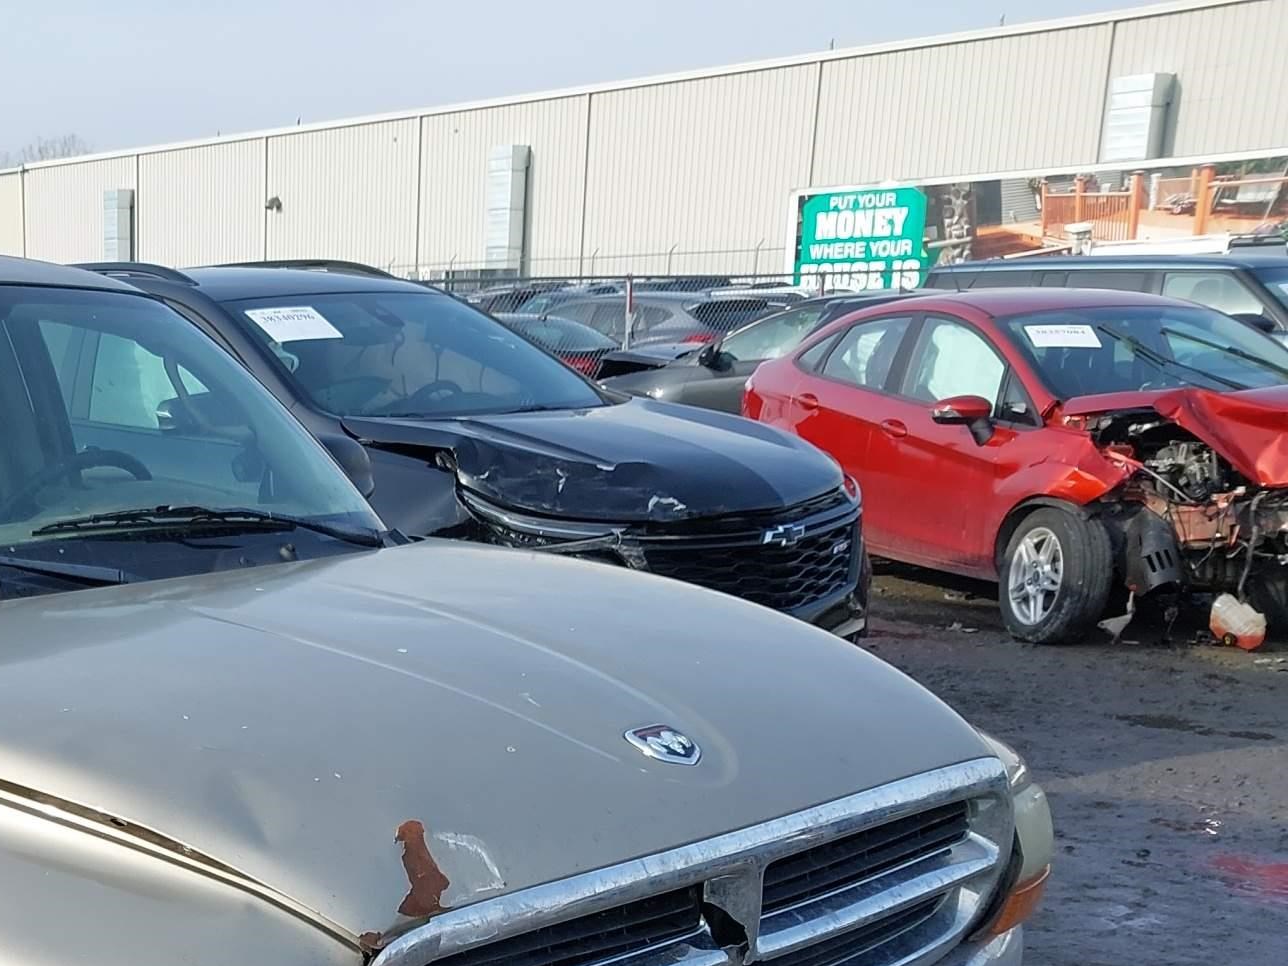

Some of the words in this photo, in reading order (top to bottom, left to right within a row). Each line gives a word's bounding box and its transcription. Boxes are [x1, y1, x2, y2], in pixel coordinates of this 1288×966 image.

[829, 196, 856, 210] PUT
[857, 192, 897, 208] YOUR
[815, 206, 909, 240] MONEY
[809, 241, 867, 260] WHERE
[869, 239, 913, 258] YOUR
[799, 261, 886, 290] HOUSE
[891, 258, 921, 290] IS
